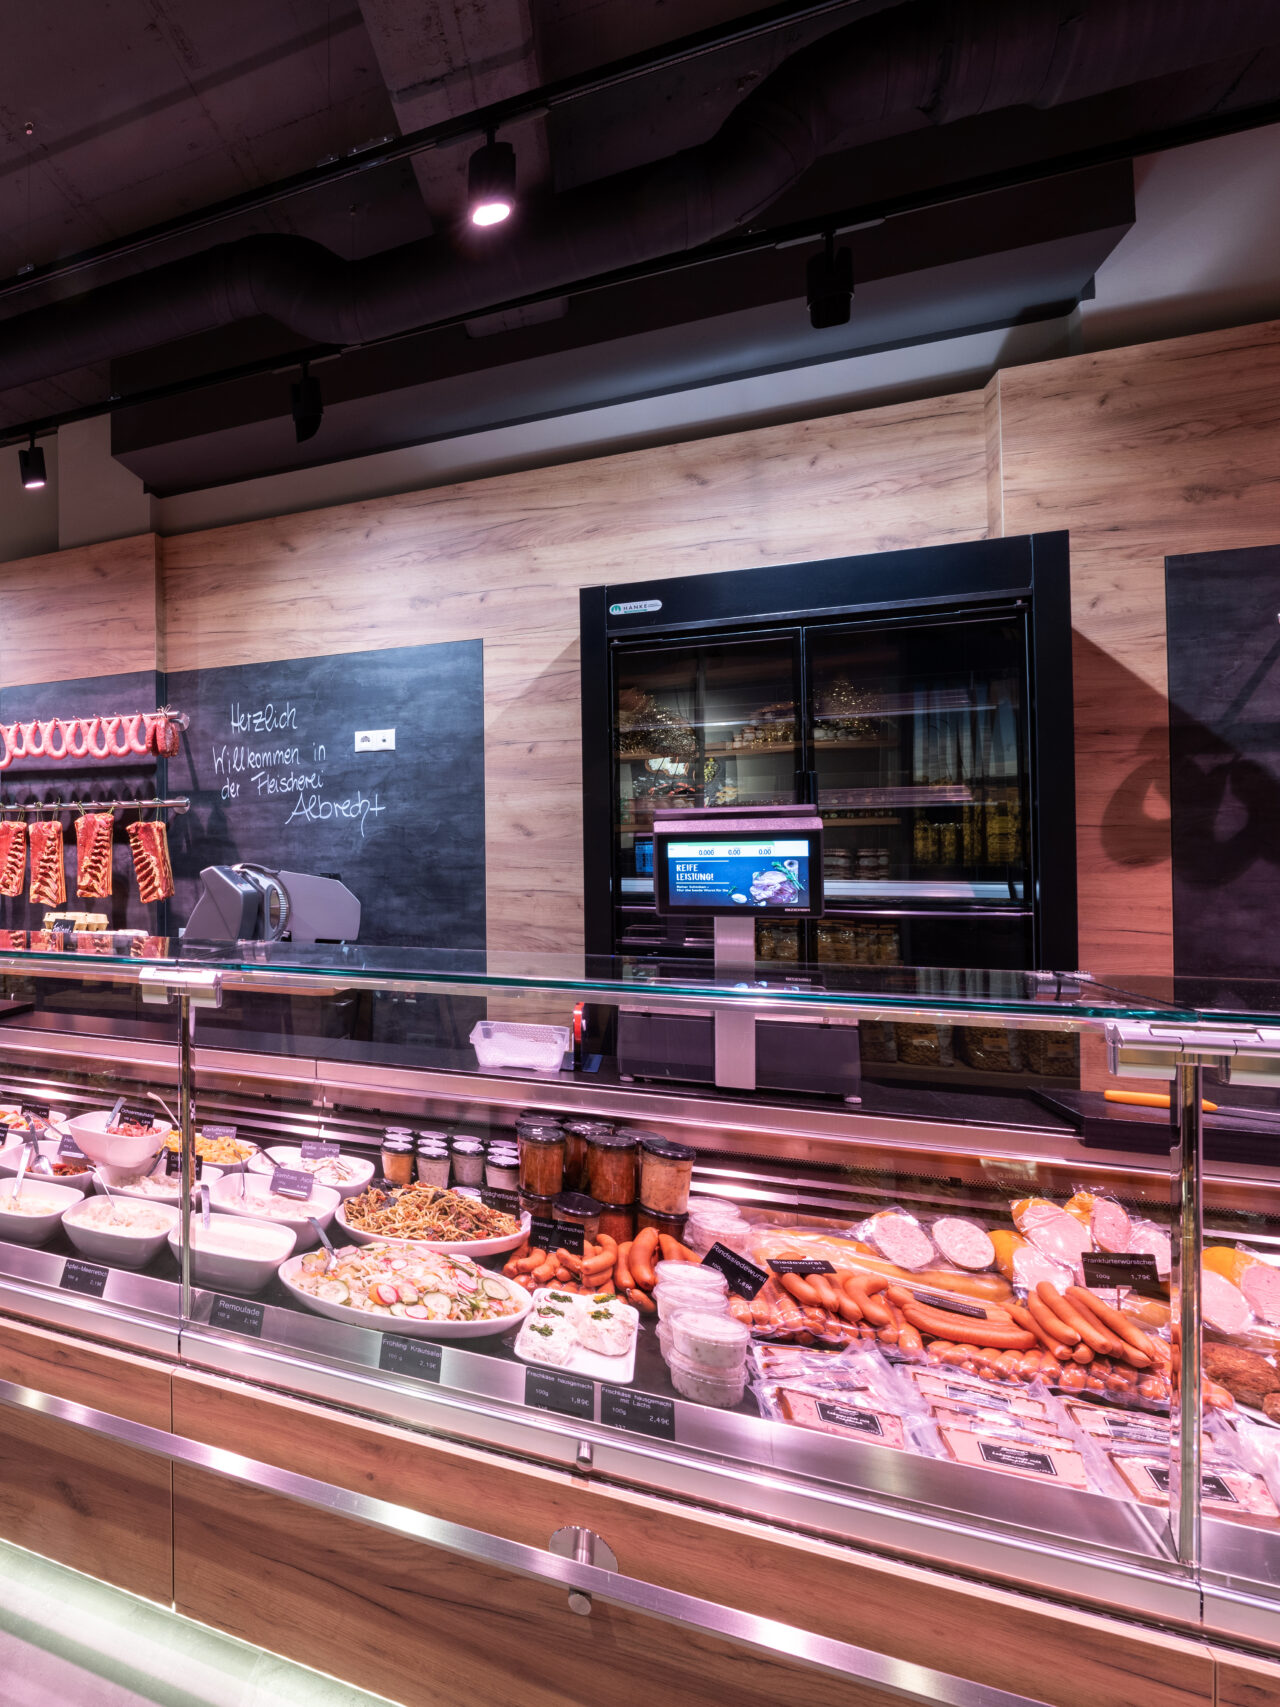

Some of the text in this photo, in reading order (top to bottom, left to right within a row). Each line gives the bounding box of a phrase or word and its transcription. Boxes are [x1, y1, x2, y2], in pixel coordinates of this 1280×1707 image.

[231, 702, 298, 734] Herzlich
[212, 742, 326, 774] Willkommen in
[221, 770, 324, 800] der Fleischerei
[285, 791, 386, 838] Albrecht
[676, 864, 698, 872] REIFE
[676, 872, 714, 881] LEISTUNG!
[712, 1244, 767, 1284] Rindssiedewurst
[1130, 1273, 1151, 1281] 1,79€
[219, 1299, 260, 1317] Remoulade
[557, 1377, 593, 1390] hausgemacht
[535, 1388, 590, 1407] 100g 1,89€
[620, 1396, 651, 1410] mit Lachs
[634, 1394, 672, 1408] hausgemacht
[612, 1407, 670, 1426] 100g 2,49€
